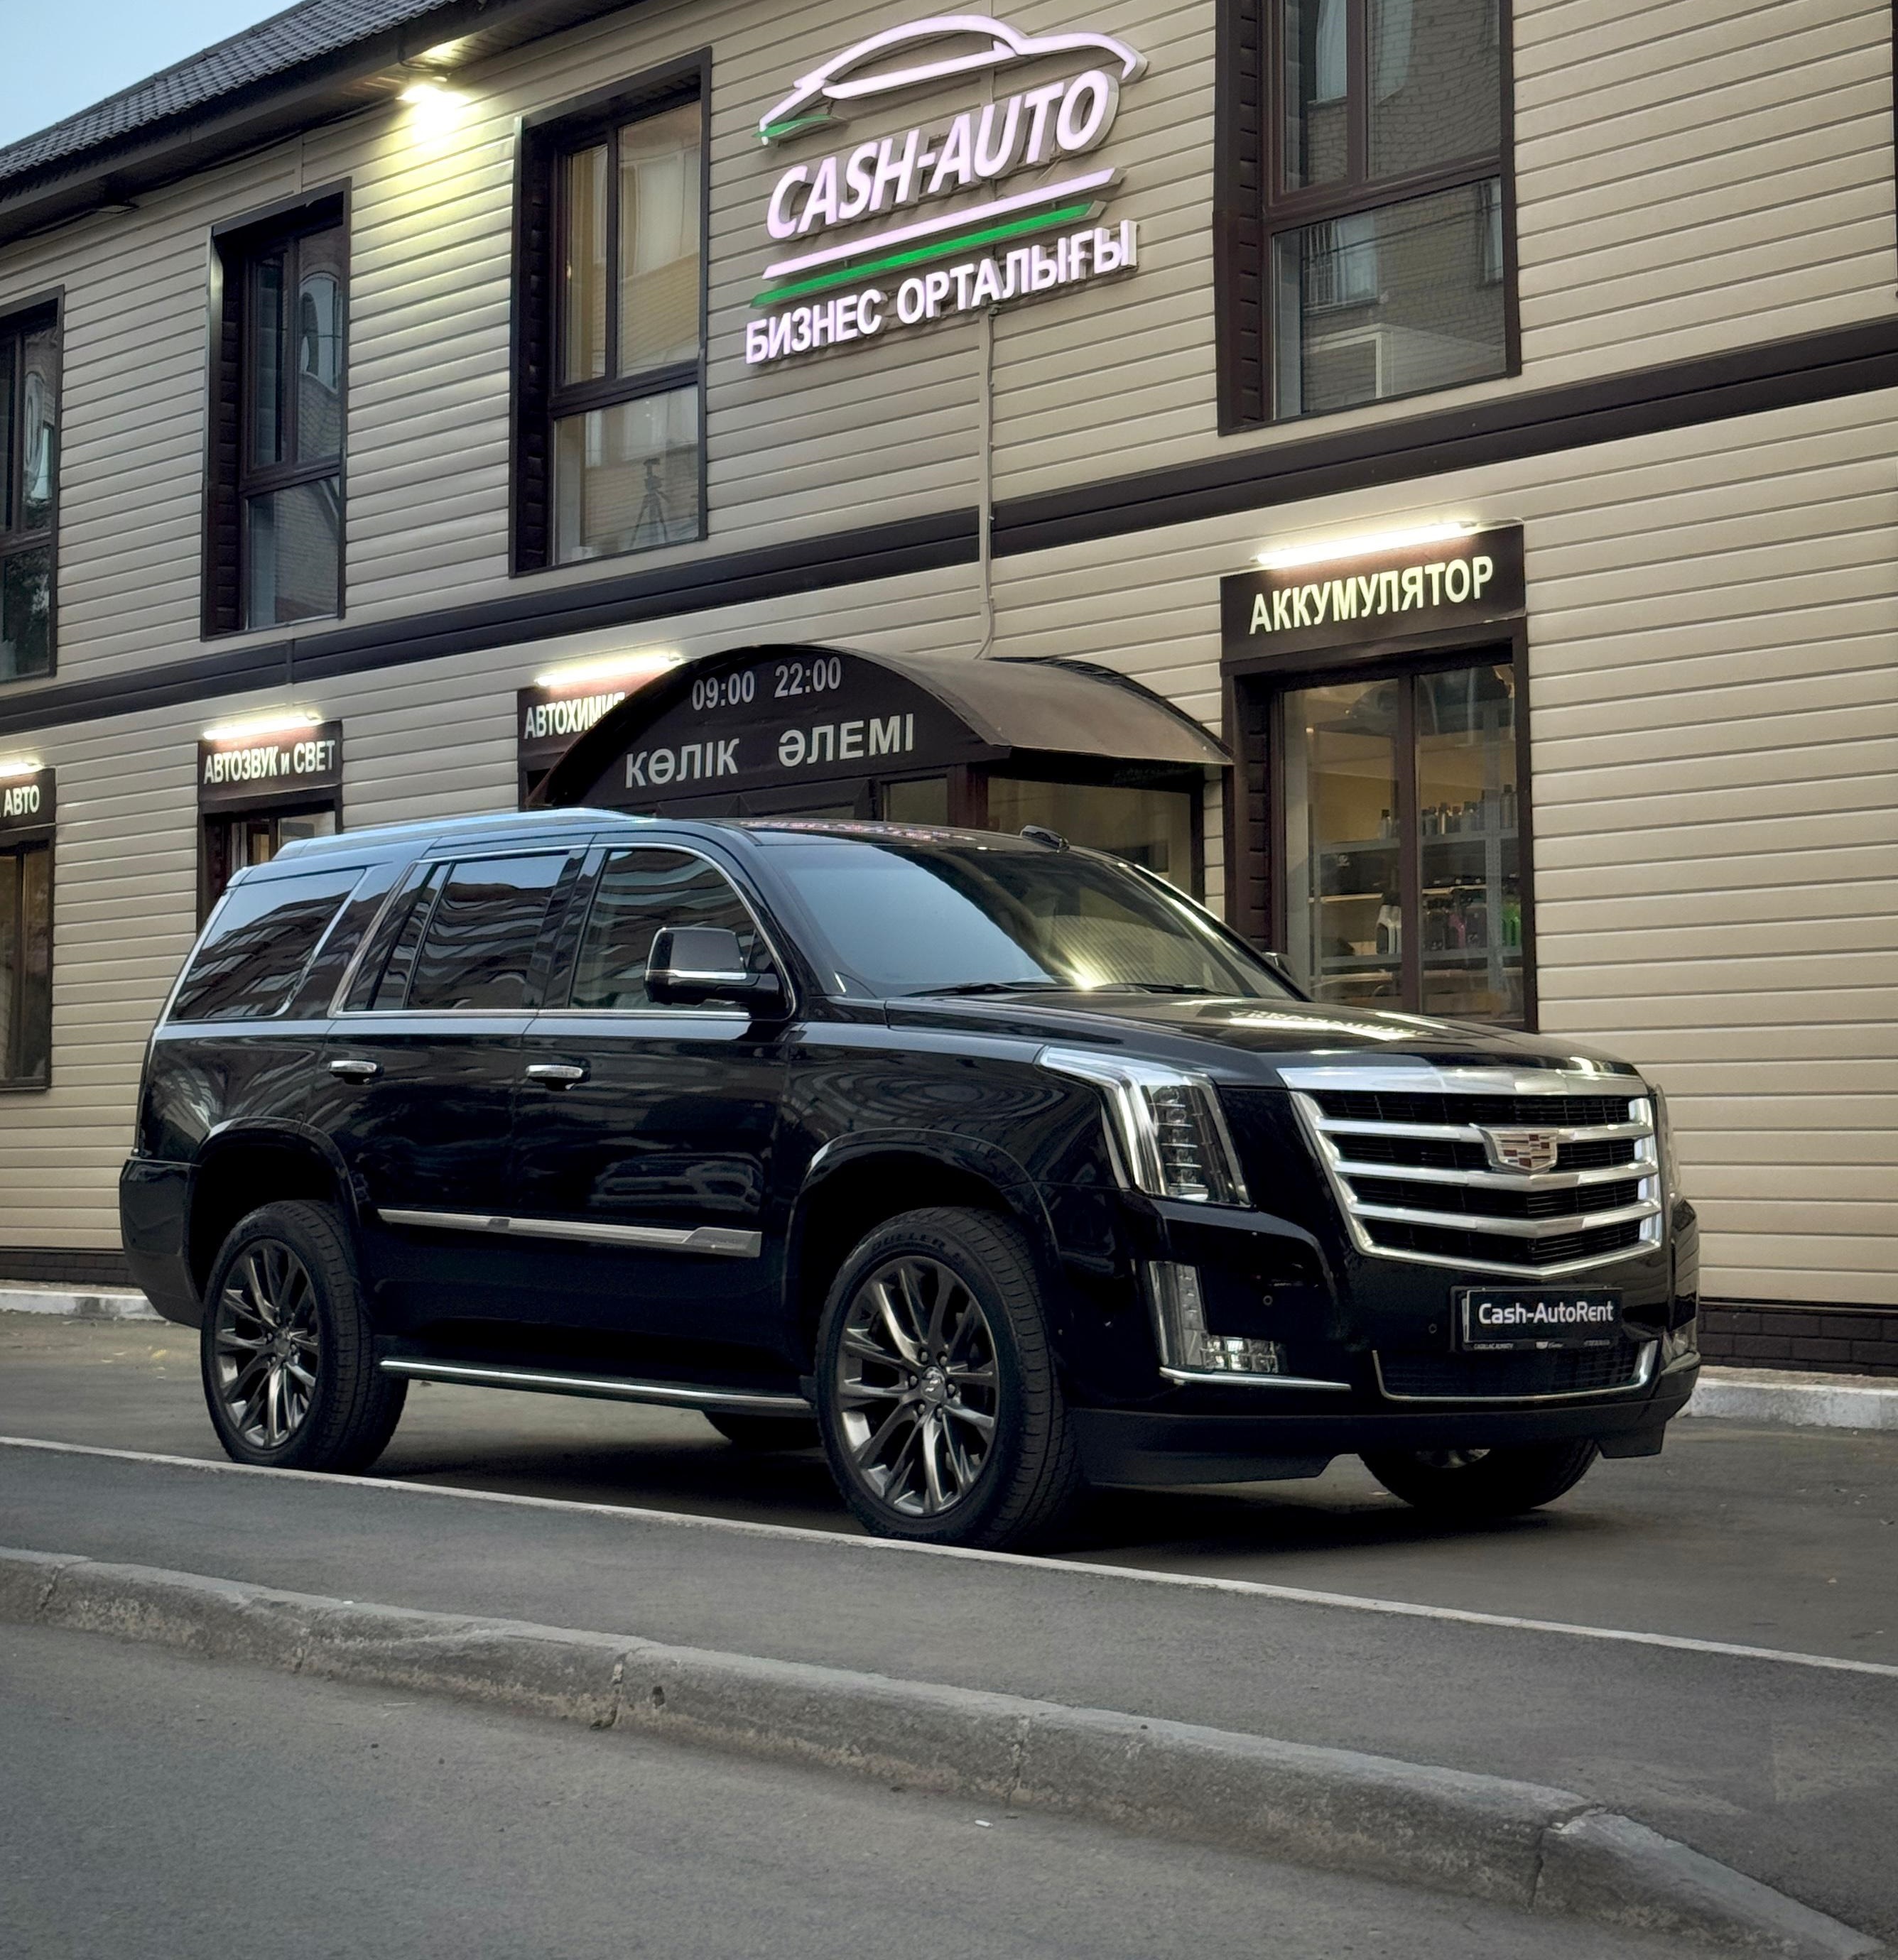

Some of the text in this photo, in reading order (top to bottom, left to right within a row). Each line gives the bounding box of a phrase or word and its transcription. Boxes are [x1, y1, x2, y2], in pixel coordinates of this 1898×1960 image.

[767, 70, 1117, 239] CASH-AUTO
[746, 220, 1137, 364] БИЗНЕС ОРТАЛЫҒЫ
[1249, 555, 1493, 635] АККУМУЛЯТОР
[692, 657, 842, 711] 09:00 22:00
[204, 746, 279, 784] АВТОЗВУК
[293, 740, 335, 775] СВЕТ
[625, 713, 915, 788] КӨЛІК ӘЛЕМІ
[3, 785, 40, 817] АВТО
[1478, 1301, 1614, 1324] Cash-AutoRent
